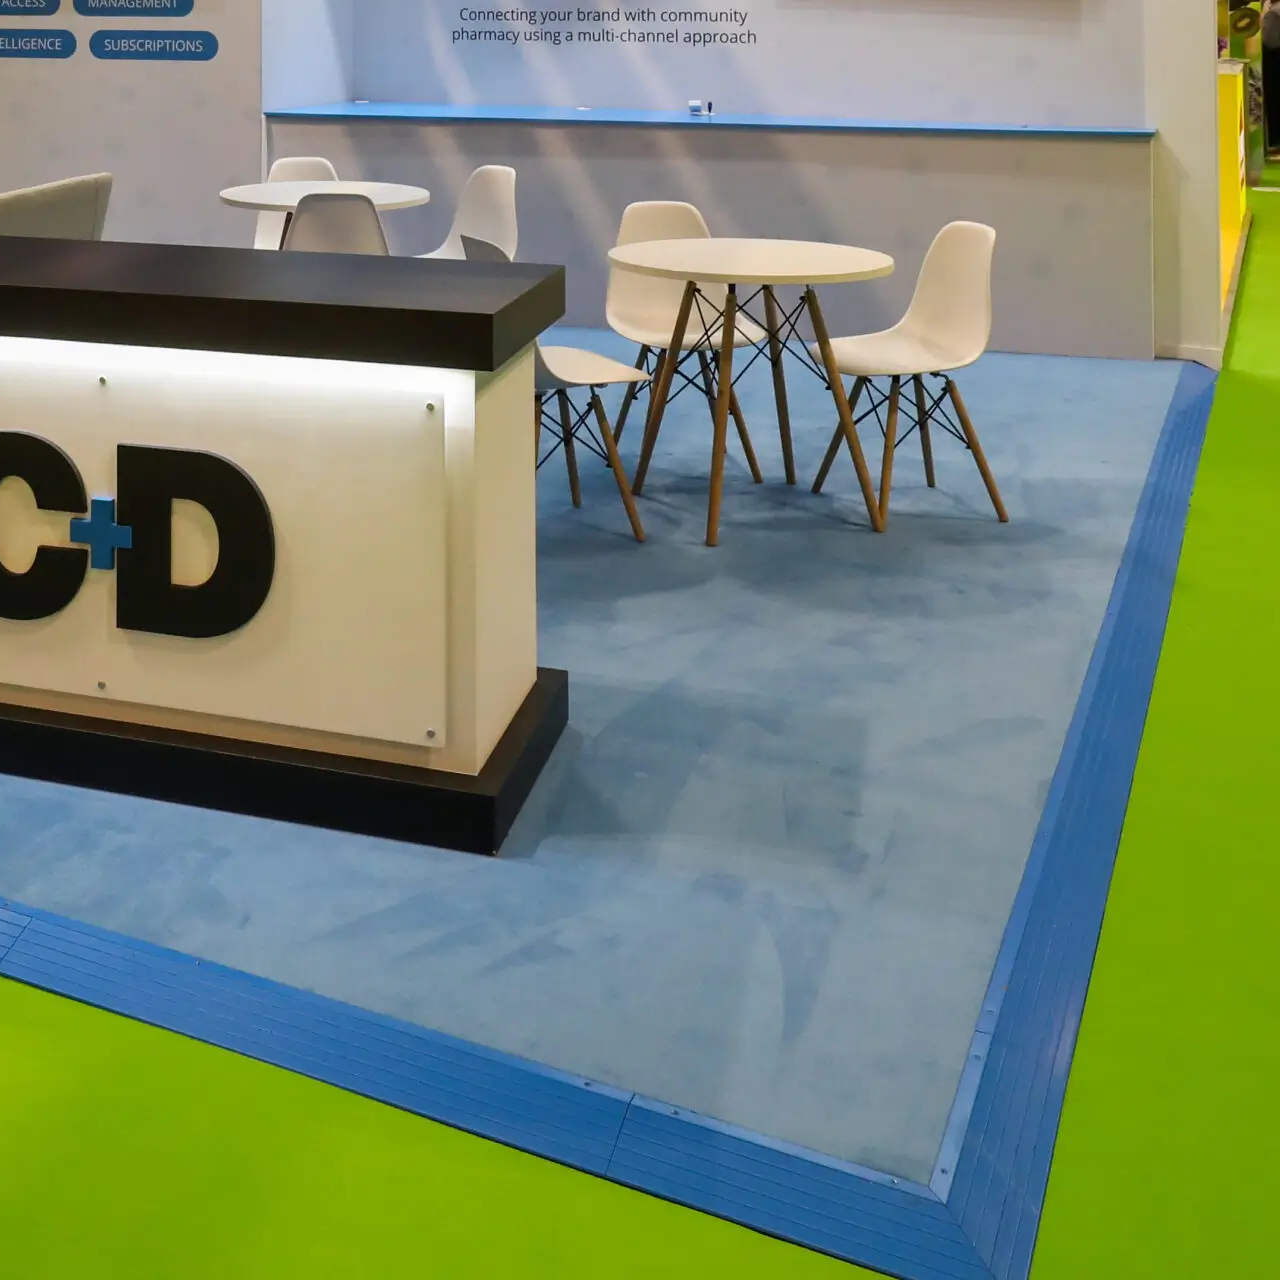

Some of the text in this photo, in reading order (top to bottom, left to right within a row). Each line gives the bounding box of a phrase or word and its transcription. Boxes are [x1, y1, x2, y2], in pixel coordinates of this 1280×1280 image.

[459, 8, 748, 26] Connecting your brand with community
[104, 39, 203, 52] SUBSCRIPTIONS
[452, 28, 757, 47] pharmacy using a multi-channel approach
